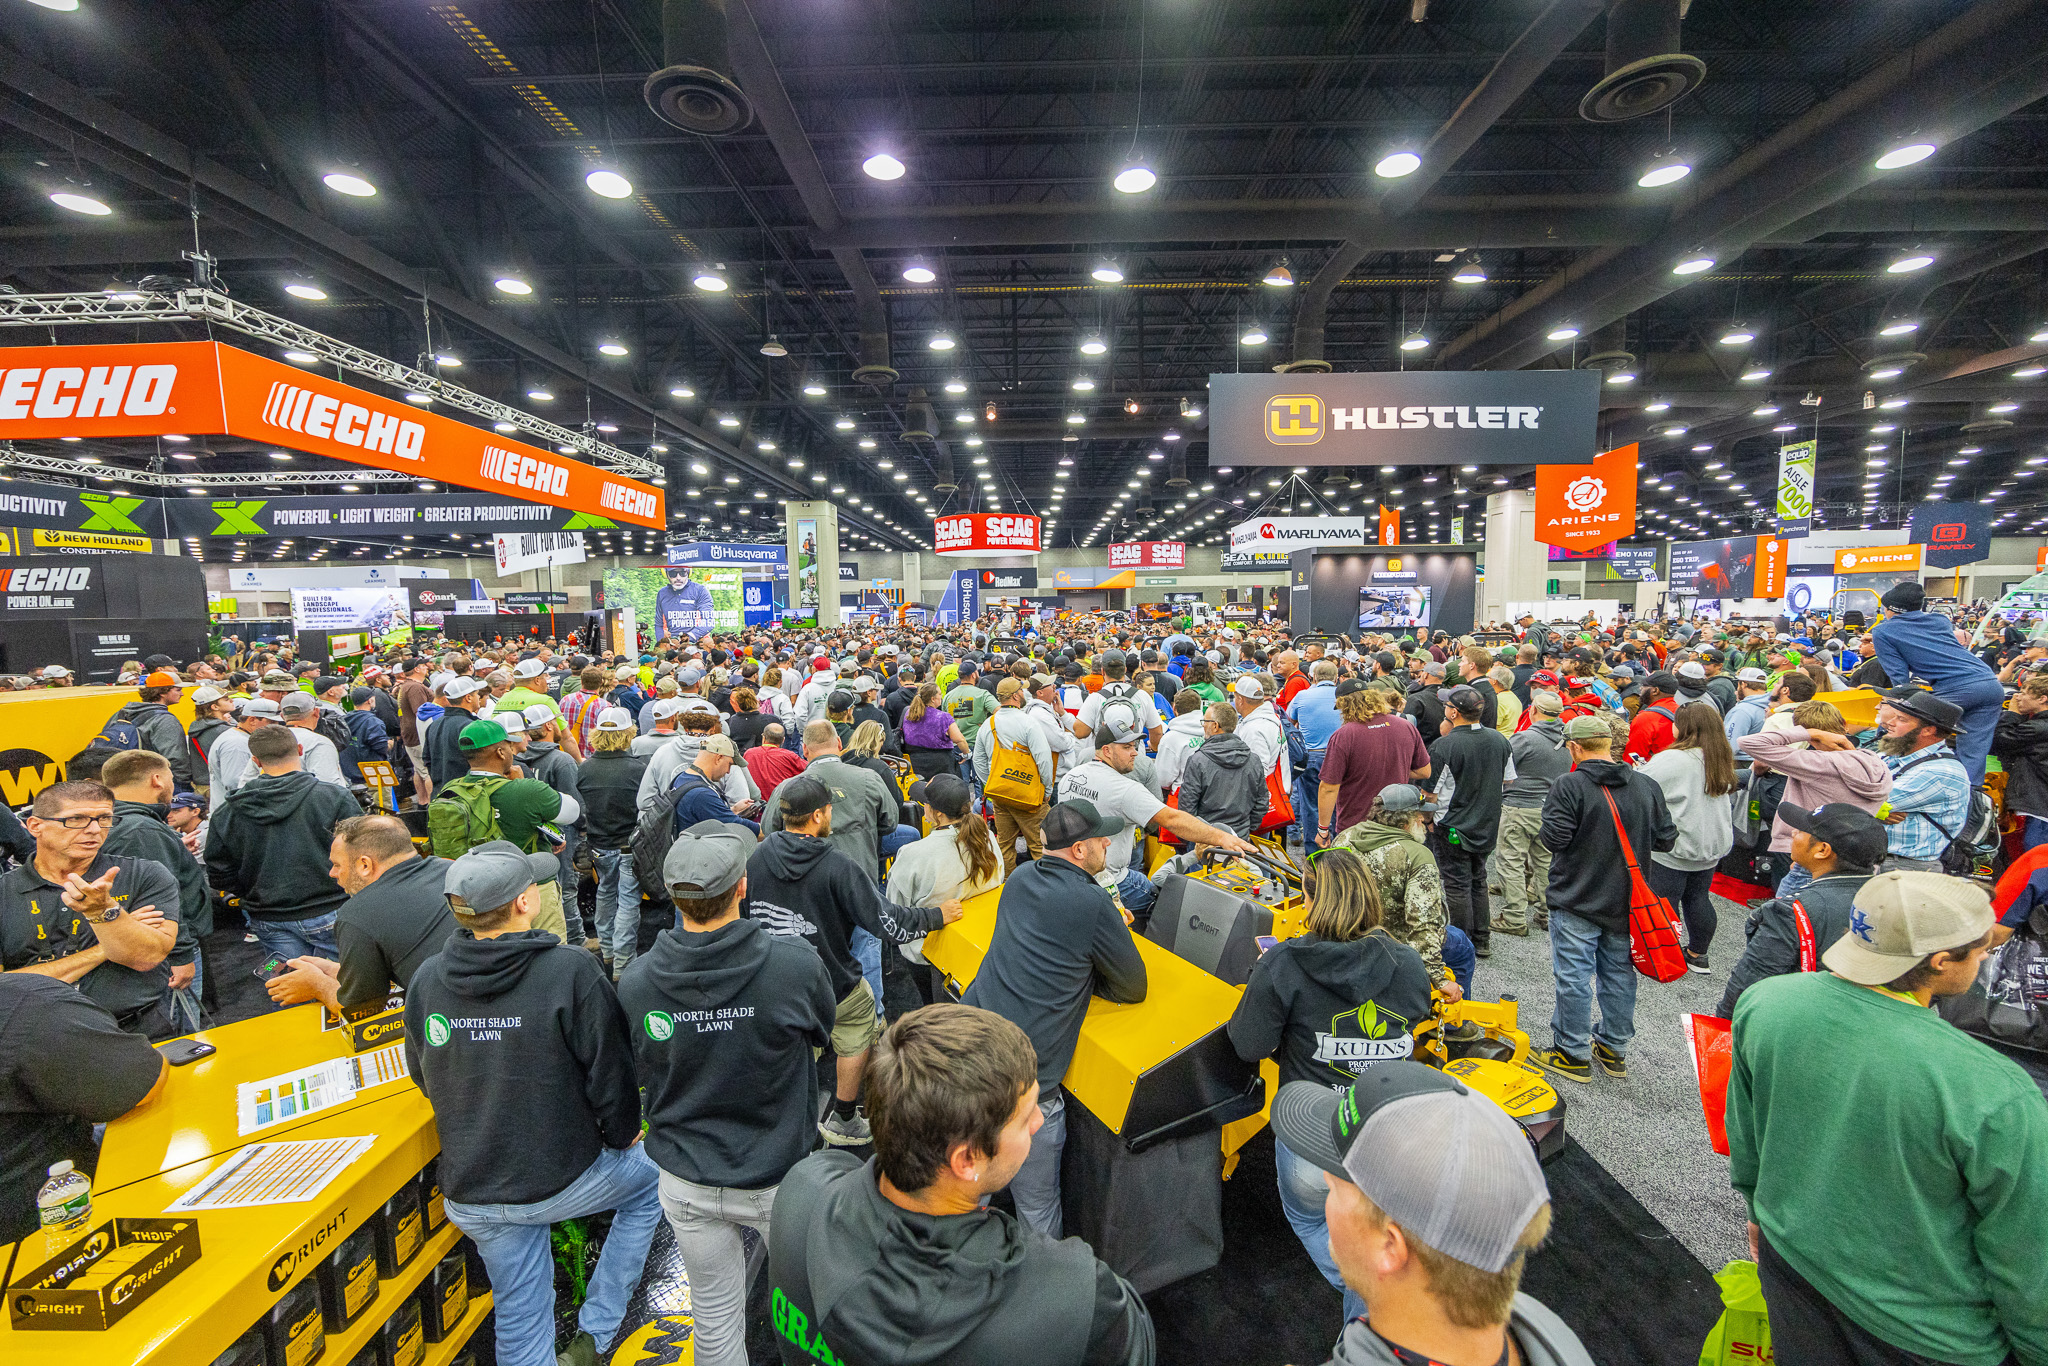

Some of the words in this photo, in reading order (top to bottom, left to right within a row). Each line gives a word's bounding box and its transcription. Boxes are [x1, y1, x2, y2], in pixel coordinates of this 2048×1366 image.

[0, 364, 177, 419] ECHO
[1332, 406, 1539, 430] HUSTLER
[303, 394, 426, 461] ECHO
[1786, 448, 1809, 460] equip
[502, 454, 569, 497] ECHO
[1784, 466, 1808, 491] AISLE
[614, 484, 657, 518] ECHO
[1778, 477, 1812, 517] 7000
[273, 510, 331, 525] POWERFUL
[340, 508, 371, 523] LIGHT
[373, 507, 415, 523] WEIGHT
[424, 507, 472, 522] GREATER
[473, 506, 553, 521] PRODUCTIVITY
[1547, 513, 1620, 526] ARIENS
[936, 518, 972, 541] SCAG
[986, 517, 1033, 538] SCAG
[1277, 529, 1361, 538] MARUYAMA
[1783, 525, 1807, 534] synchrony
[64, 534, 90, 543] NEW
[93, 536, 143, 546] HOLLAND
[520, 533, 538, 557] BUILT
[540, 532, 555, 552] FOR
[556, 532, 578, 550] THIS.
[987, 537, 1008, 545] POWER
[1010, 537, 1033, 546] EQUIPMENT
[722, 547, 777, 560] Husqvarna
[1111, 544, 1141, 560] SCAG
[1152, 544, 1182, 558] SCAG
[1860, 554, 1913, 563] ARIENS
[8, 567, 91, 592] ECHO
[995, 576, 1021, 588] RedMax
[1766, 555, 1775, 593] ARIENS
[7, 596, 38, 608] POWER
[668, 611, 700, 619] DEDICATED
[701, 611, 709, 619] TO
[671, 619, 693, 627] POWER
[694, 619, 706, 627] FOR
[720, 619, 738, 627] YEARS
[1004, 768, 1034, 782] CASE
[1069, 781, 1099, 801] KENTUCKIANA
[1189, 914, 1219, 937] WRIGHT
[2027, 964, 2042, 975] WE
[450, 1017, 486, 1029] NORTH
[488, 1016, 521, 1028] SHADE
[673, 1010, 715, 1023] NORTH
[715, 1007, 755, 1019] SHADE
[696, 1020, 733, 1033] LAWN
[471, 1030, 502, 1041] LAWN
[1334, 1040, 1406, 1056] KUHNS
[41, 1207, 64, 1218] Poland
[43, 1212, 67, 1223] Spring
[267, 1208, 348, 1292] WRIGHT
[110, 1245, 184, 1305] WRIGHT
[348, 1254, 372, 1281] WRIGHT
[15, 1294, 84, 1316] WRIGHT
[288, 1307, 317, 1339] WRIGHT
